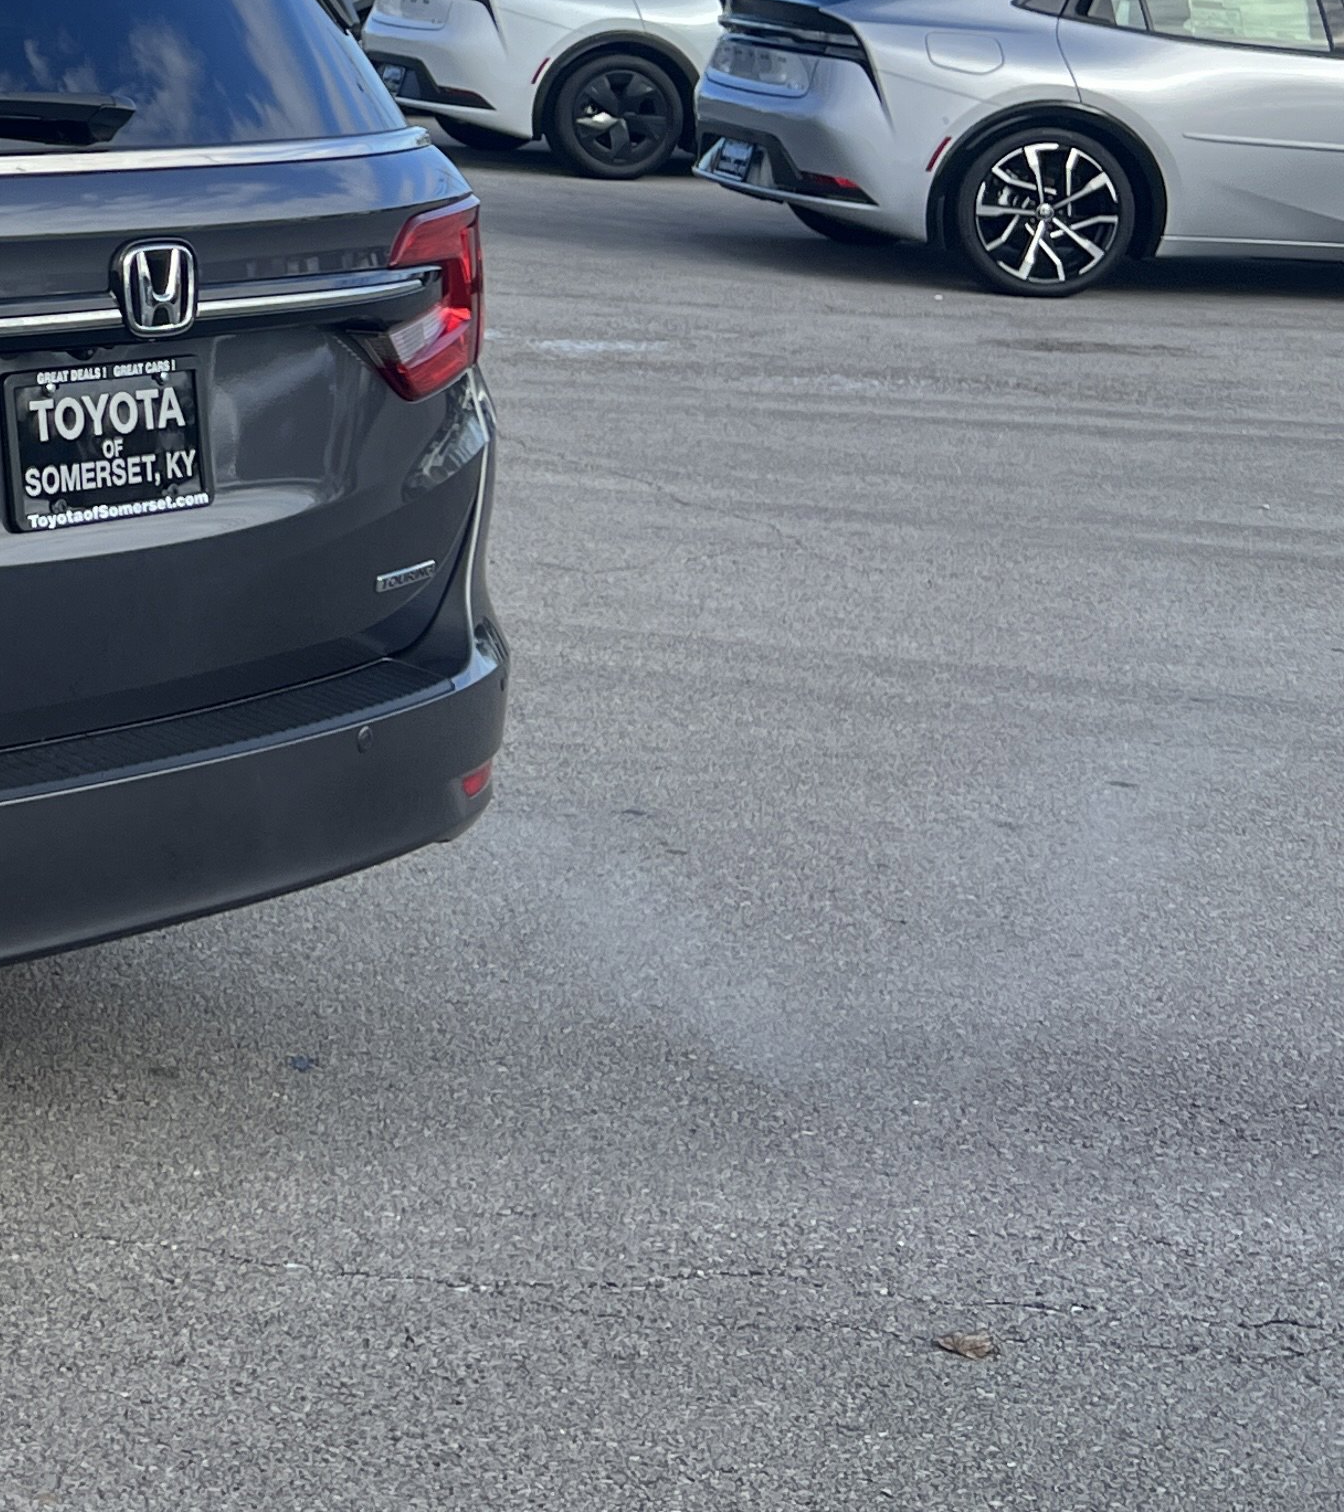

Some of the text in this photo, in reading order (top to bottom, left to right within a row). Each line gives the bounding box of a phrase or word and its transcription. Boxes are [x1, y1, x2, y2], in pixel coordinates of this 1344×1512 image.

[36, 369, 69, 385] GREAT
[113, 363, 144, 377] GREAT
[29, 387, 186, 442] TOYOTA
[102, 439, 124, 459] OF
[25, 449, 196, 497] SOMERSET, KY
[27, 491, 209, 529] ToyotaofSomerset.com
